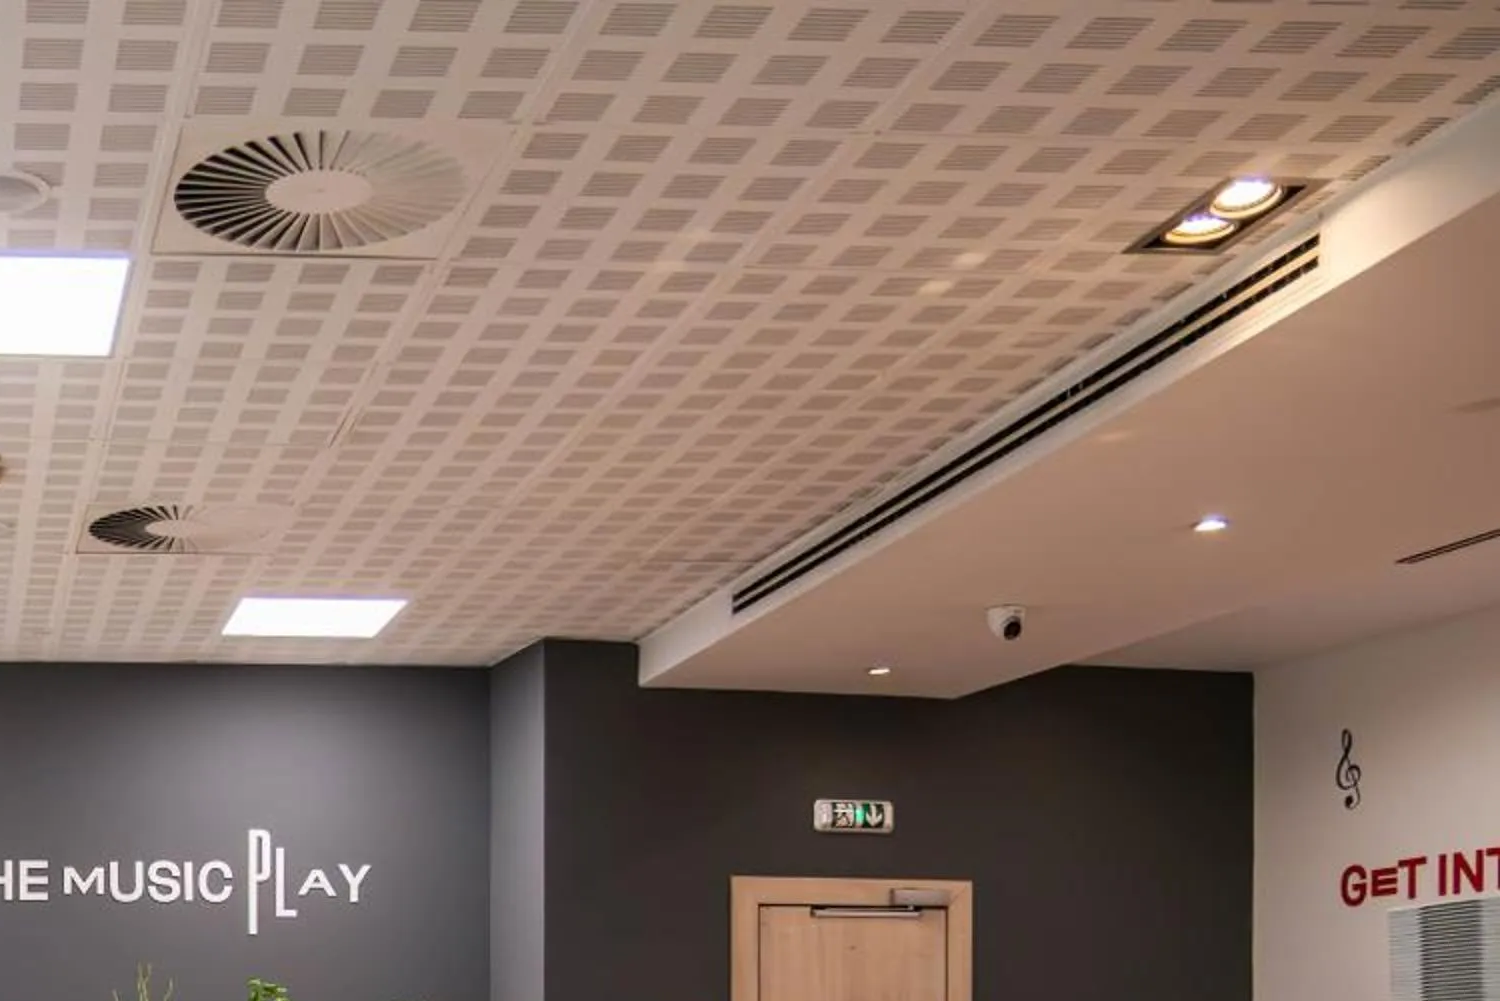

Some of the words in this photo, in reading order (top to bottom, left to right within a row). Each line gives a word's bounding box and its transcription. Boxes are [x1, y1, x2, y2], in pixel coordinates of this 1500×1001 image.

[62, 858, 235, 905] MUSIC
[247, 827, 373, 935] PLAY
[1341, 856, 1428, 906] GET
